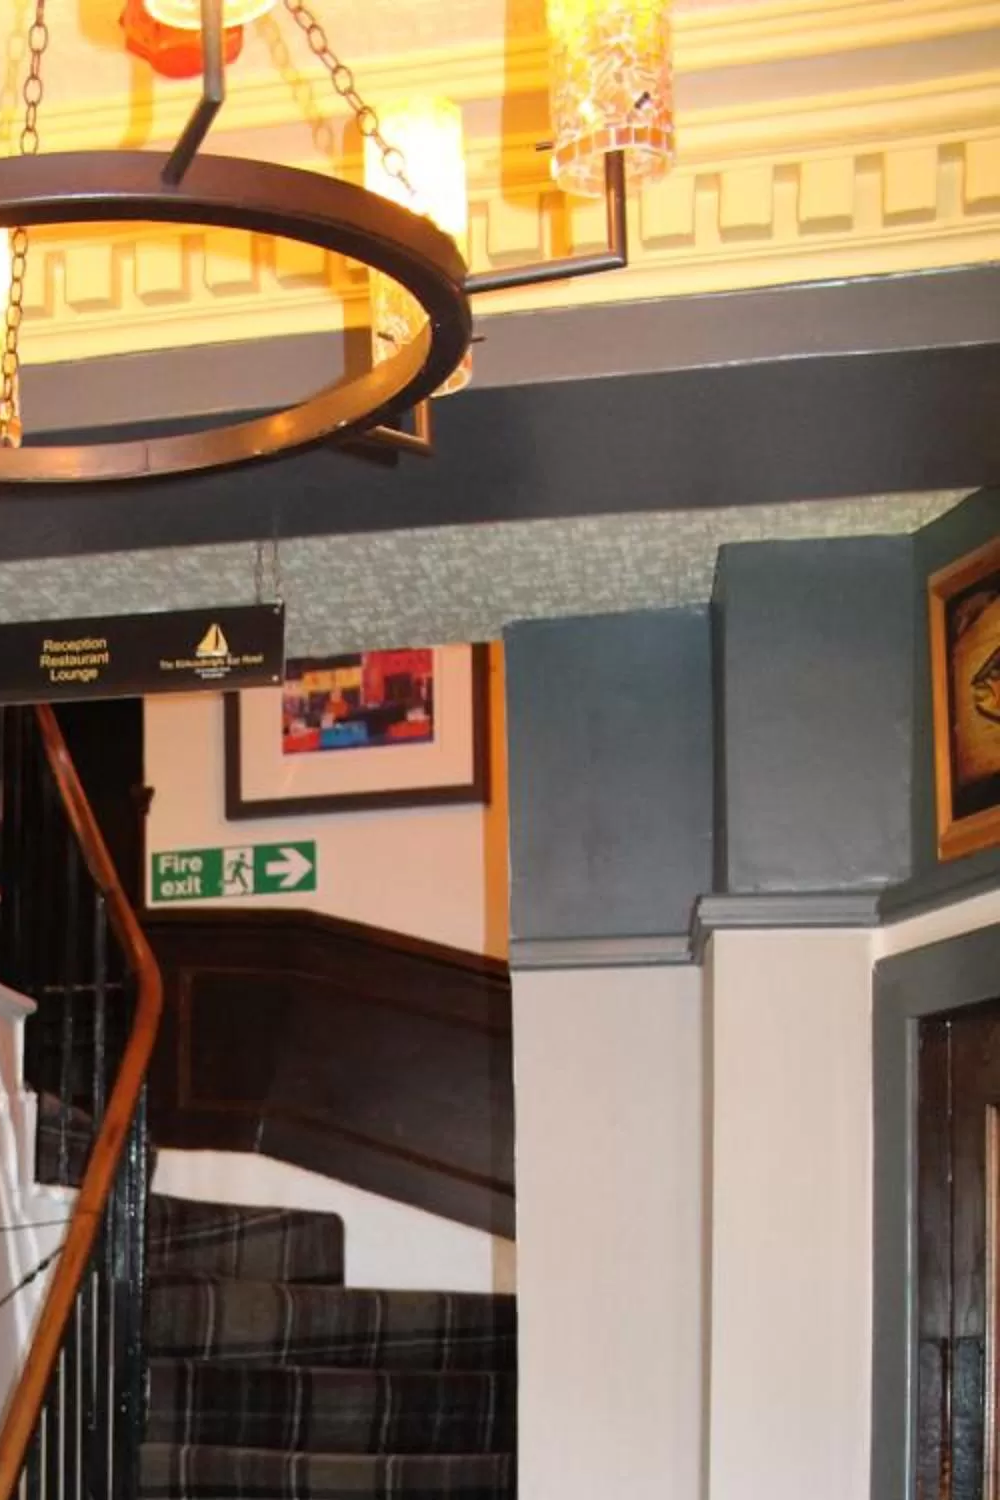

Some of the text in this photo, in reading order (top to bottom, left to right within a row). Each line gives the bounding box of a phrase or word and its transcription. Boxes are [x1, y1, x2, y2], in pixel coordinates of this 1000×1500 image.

[43, 637, 107, 653] Reception
[40, 651, 109, 669] Restaurant
[49, 667, 99, 683] Lounge
[158, 854, 203, 875] Fire
[160, 875, 202, 897] exit
